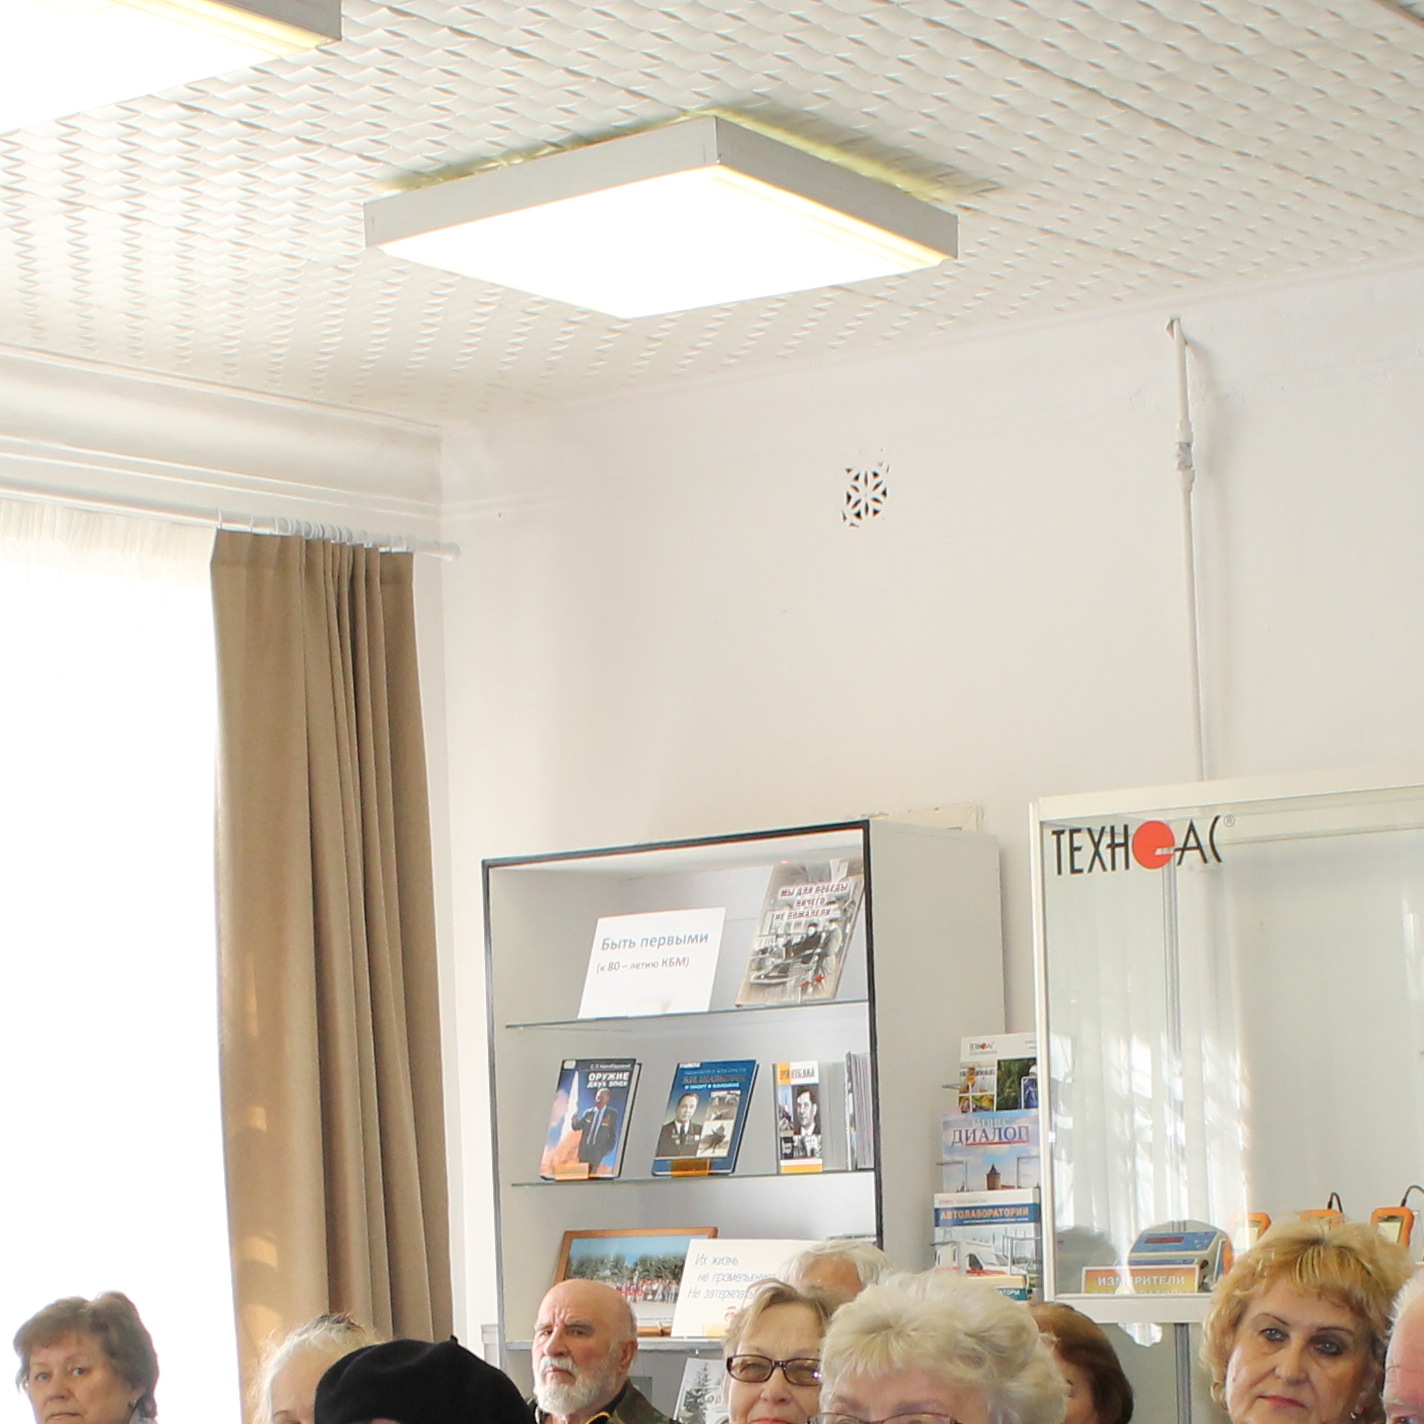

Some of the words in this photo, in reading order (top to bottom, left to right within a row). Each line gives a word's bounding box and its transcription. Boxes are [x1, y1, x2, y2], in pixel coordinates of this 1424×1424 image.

[601, 937, 636, 951] Быть
[640, 933, 709, 949] первыми
[607, 961, 621, 972] 80
[629, 961, 659, 970] летию
[661, 956, 690, 969] КБМ)
[588, 1071, 630, 1081] ОРУЖИЕ
[940, 1207, 1030, 1219] АВТОЛАБОРАТОРИИ
[695, 1253, 708, 1265] Их
[710, 1256, 739, 1265] жизнь
[688, 1287, 701, 1299] Не
